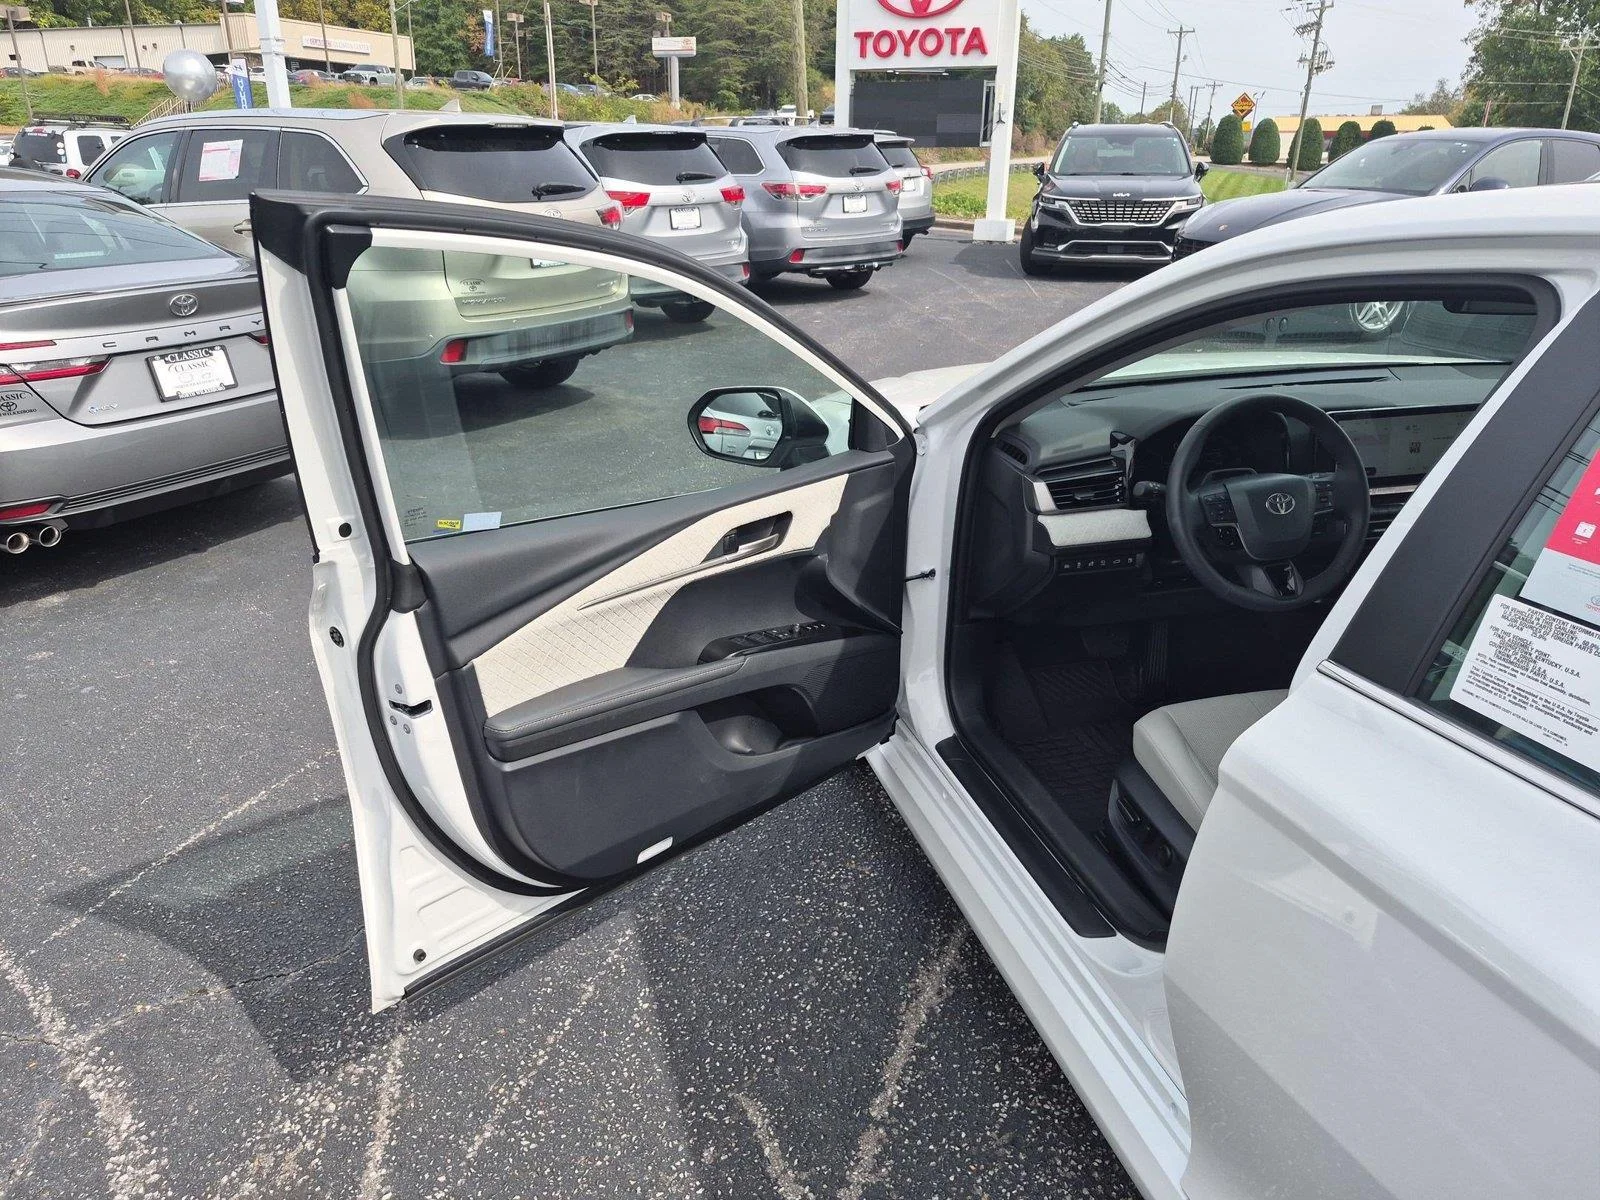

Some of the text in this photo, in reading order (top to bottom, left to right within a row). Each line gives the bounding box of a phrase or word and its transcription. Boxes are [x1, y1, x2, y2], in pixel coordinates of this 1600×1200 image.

[854, 27, 988, 58] TOYOTA
[102, 319, 263, 349] CAMRY
[167, 348, 210, 363] CLASSIC
[1499, 602, 1510, 610] FOR
[1510, 606, 1534, 619] VEHICLES
[1527, 608, 1544, 618] PARTS
[1544, 614, 1569, 627] CONTENT
[1489, 624, 1499, 632] FOR
[1500, 629, 1511, 637] THIS
[1506, 621, 1524, 631] JAPAN
[1492, 631, 1506, 640] FINAL
[1550, 633, 1573, 646] FOREIGN
[1573, 642, 1593, 654] PARTS
[1488, 640, 1511, 653] COUNTRY
